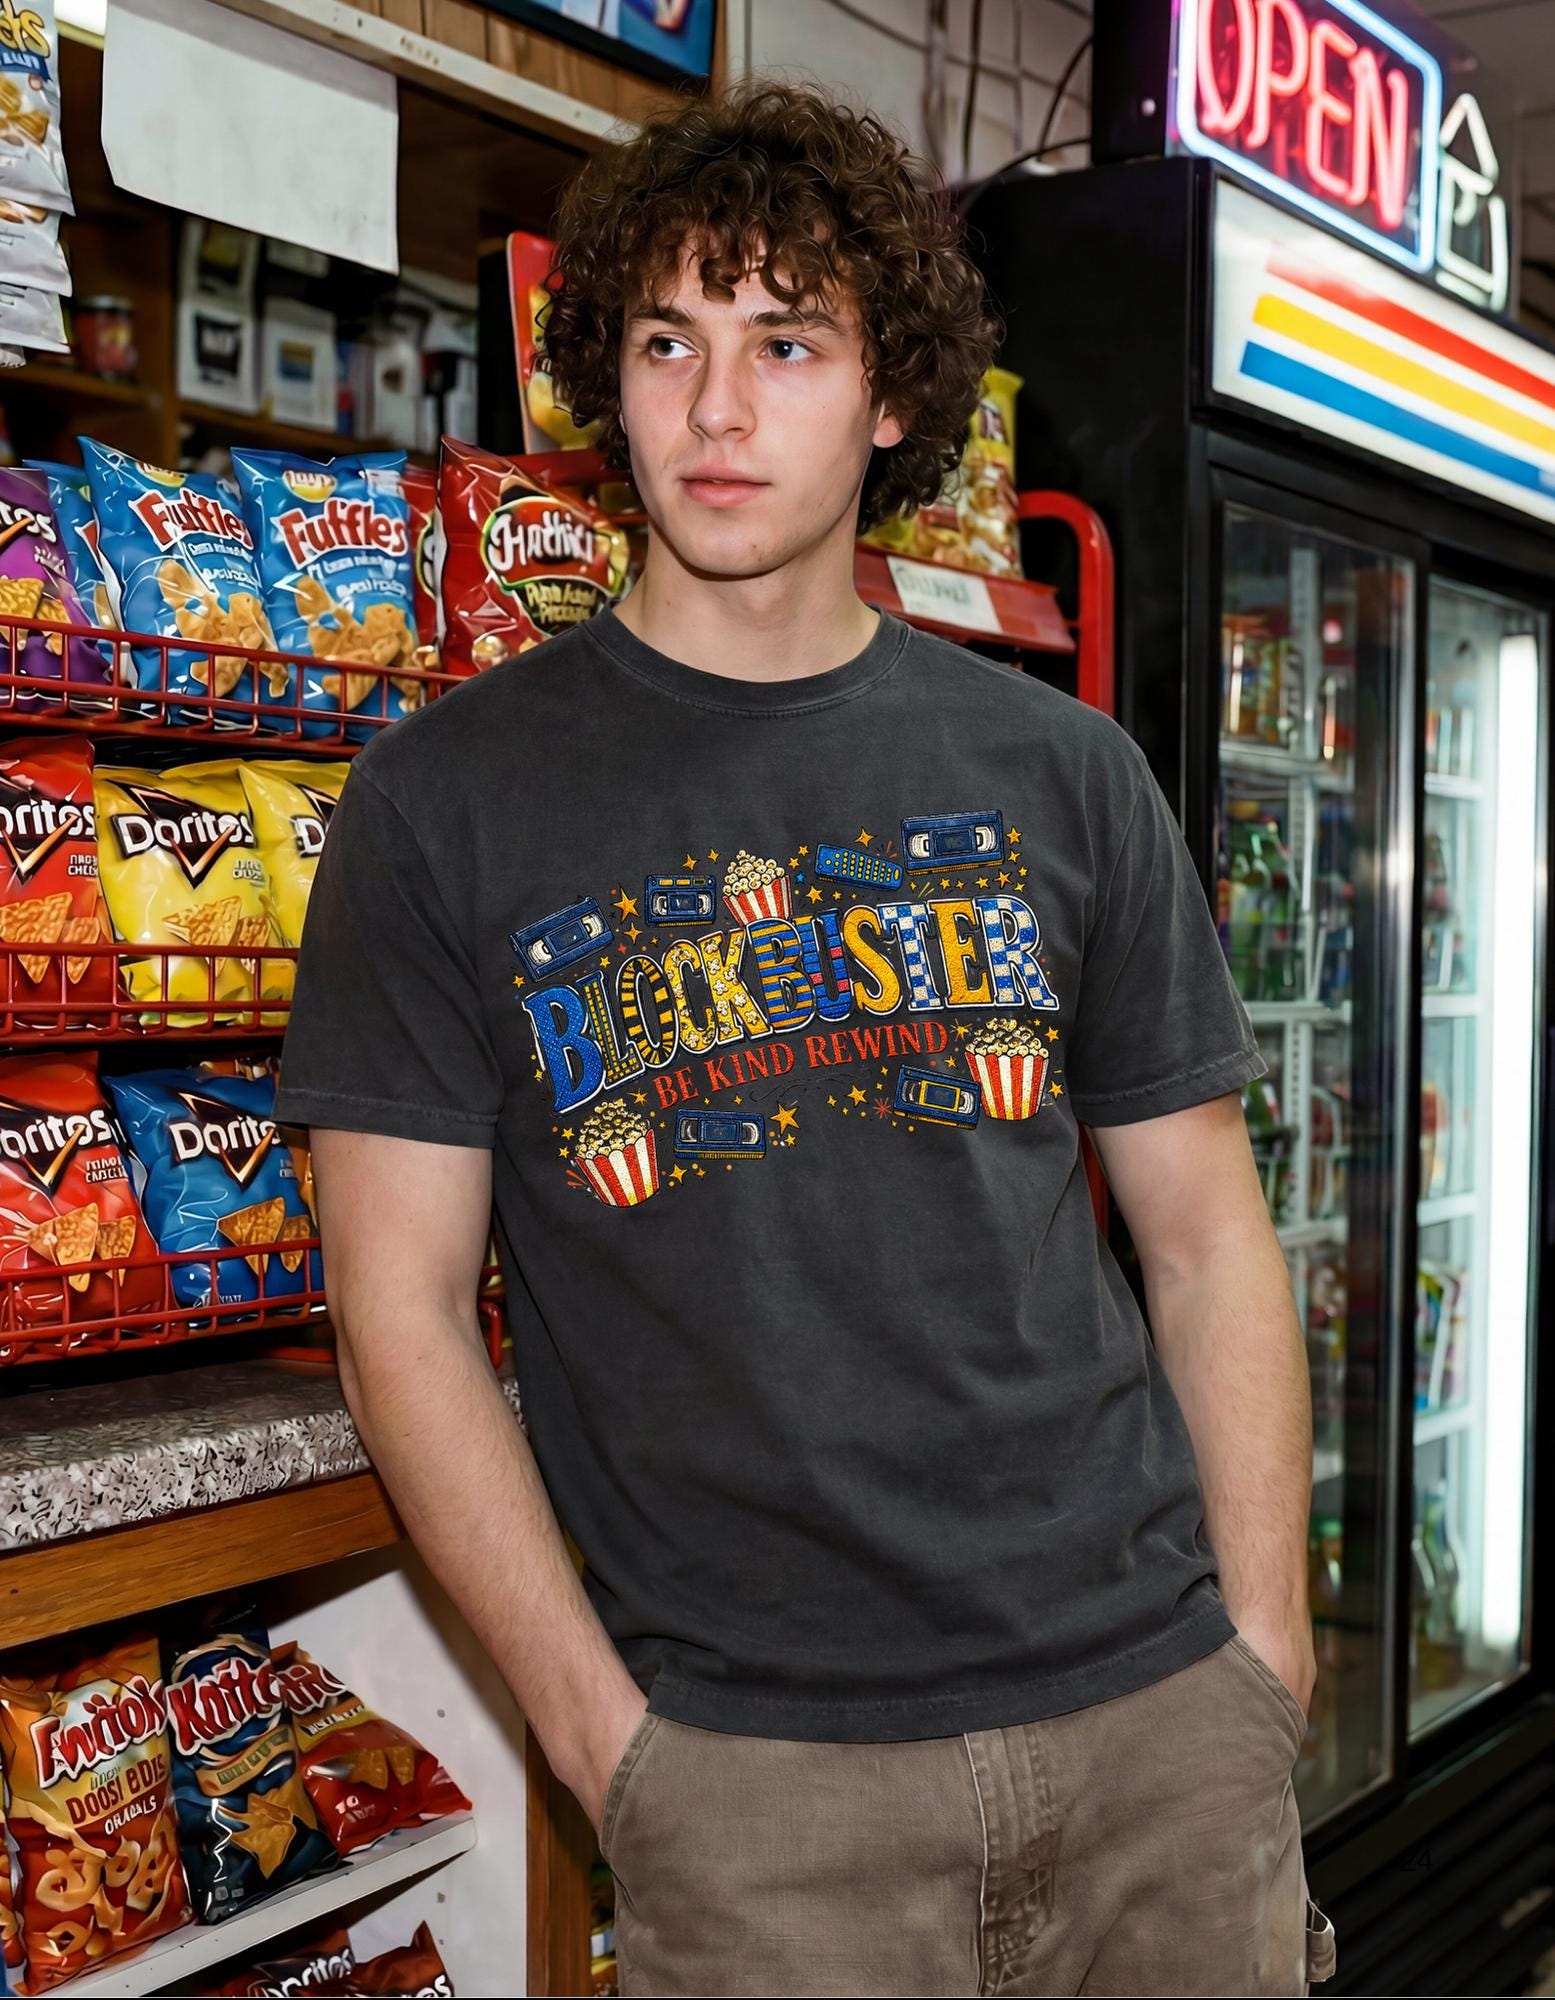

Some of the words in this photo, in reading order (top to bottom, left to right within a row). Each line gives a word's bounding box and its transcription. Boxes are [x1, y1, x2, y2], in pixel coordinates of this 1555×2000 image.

[1197, 0, 1409, 230] OPEN
[117, 811, 254, 854] Doritos
[523, 893, 1060, 1114] BLOCKBUSTER
[652, 1066, 699, 1109] BE
[704, 1042, 794, 1092] KIND
[804, 1021, 948, 1068] REWIND
